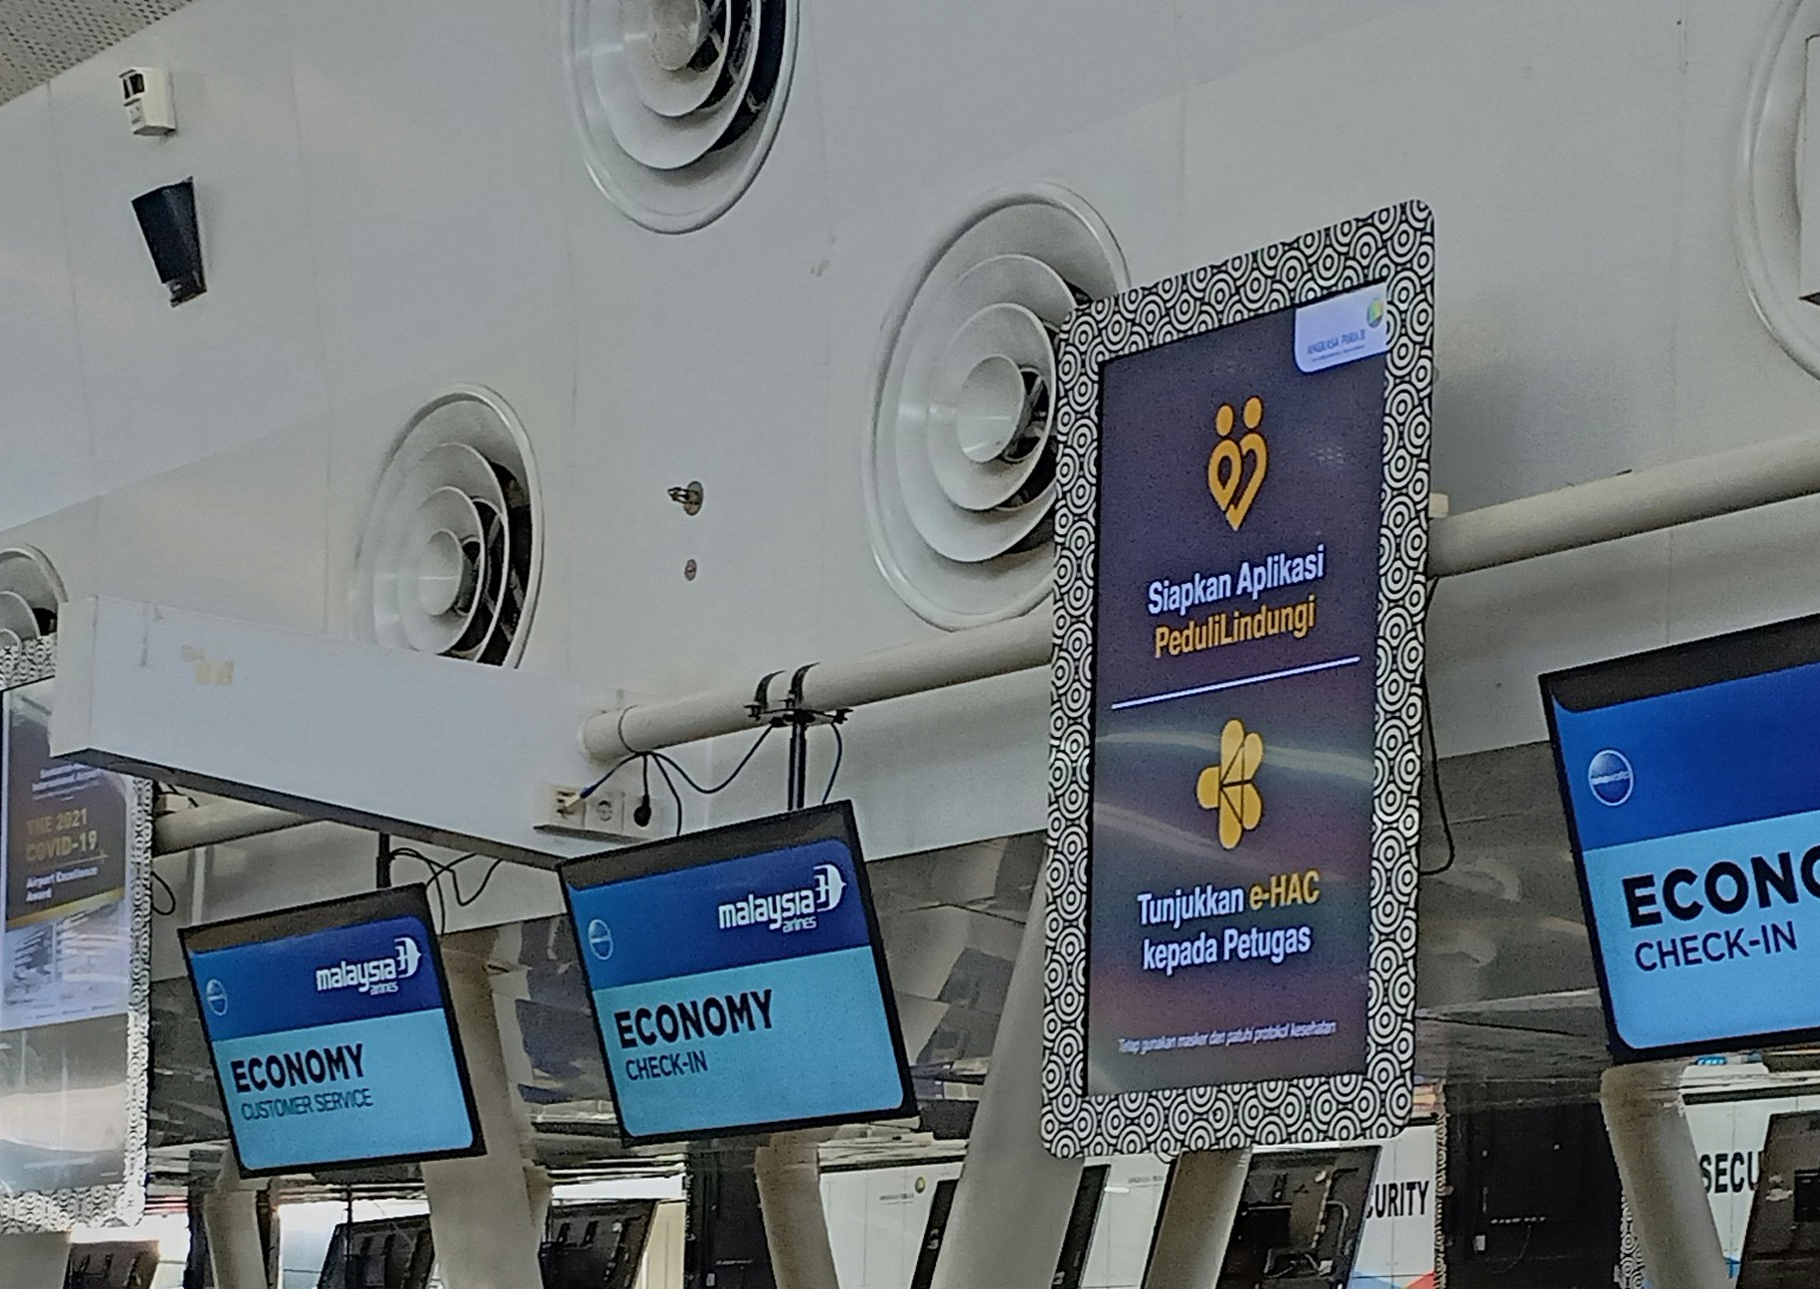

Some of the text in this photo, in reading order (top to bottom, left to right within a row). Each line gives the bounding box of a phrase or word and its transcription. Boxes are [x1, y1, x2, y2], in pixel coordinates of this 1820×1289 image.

[1148, 544, 1325, 616] Siapkan Aplikasi
[1154, 595, 1316, 658] PeduliLindungi
[26, 830, 98, 862] COVID-19
[718, 888, 816, 931] malaysia
[1137, 870, 1320, 930] Tunjukkan e-HAC
[1142, 924, 1312, 975] kepada Petugas
[1634, 921, 1798, 972] CHECK-IN
[316, 956, 396, 993] malaysia
[614, 989, 773, 1049] ECONOMY
[231, 1043, 364, 1093] ECONOMY
[625, 1050, 709, 1081] CHECK-IN
[241, 1088, 373, 1121] CUSTOMER SERVICE
